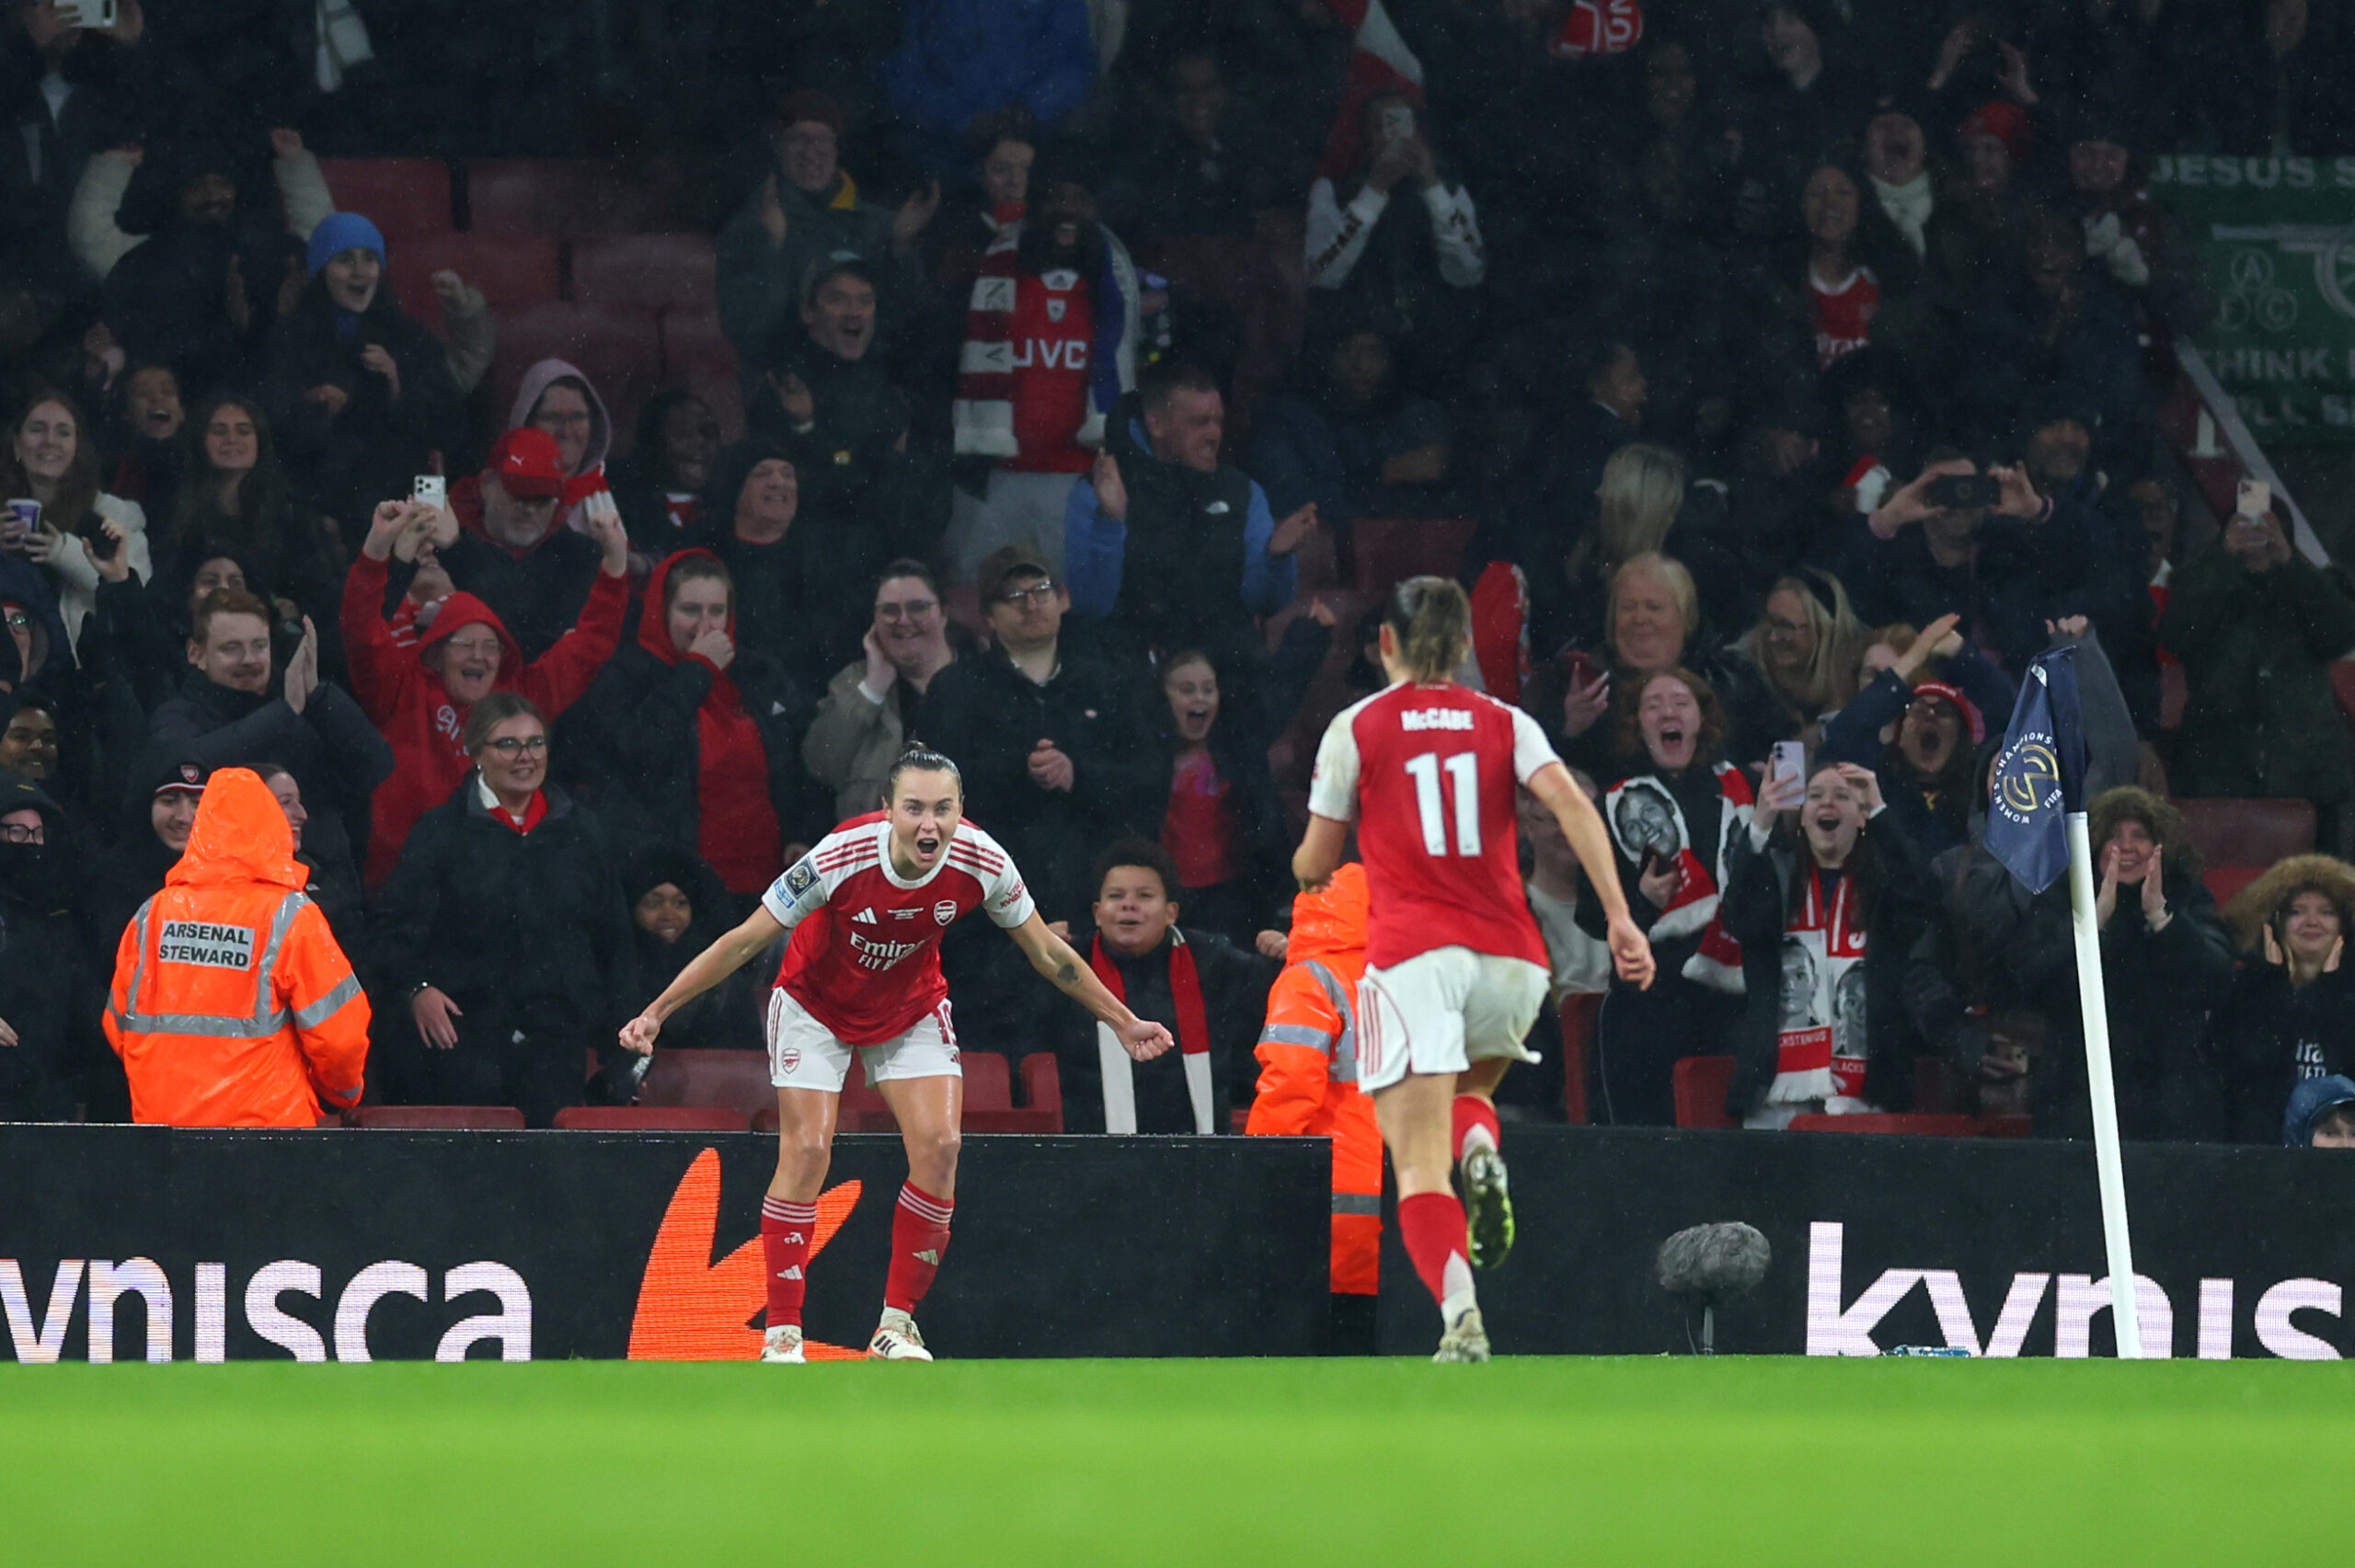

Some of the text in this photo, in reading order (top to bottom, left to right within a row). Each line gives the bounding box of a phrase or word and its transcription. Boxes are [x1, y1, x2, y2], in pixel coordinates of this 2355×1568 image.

[2148, 155, 2315, 189] JESUS
[1013, 338, 1088, 370] JVC
[1404, 751, 1483, 857] 11
[2044, 788, 2063, 809] FIFA
[164, 922, 249, 945] ARSENAL
[159, 944, 249, 967] STEWARD
[1806, 1221, 2344, 1360] kynis
